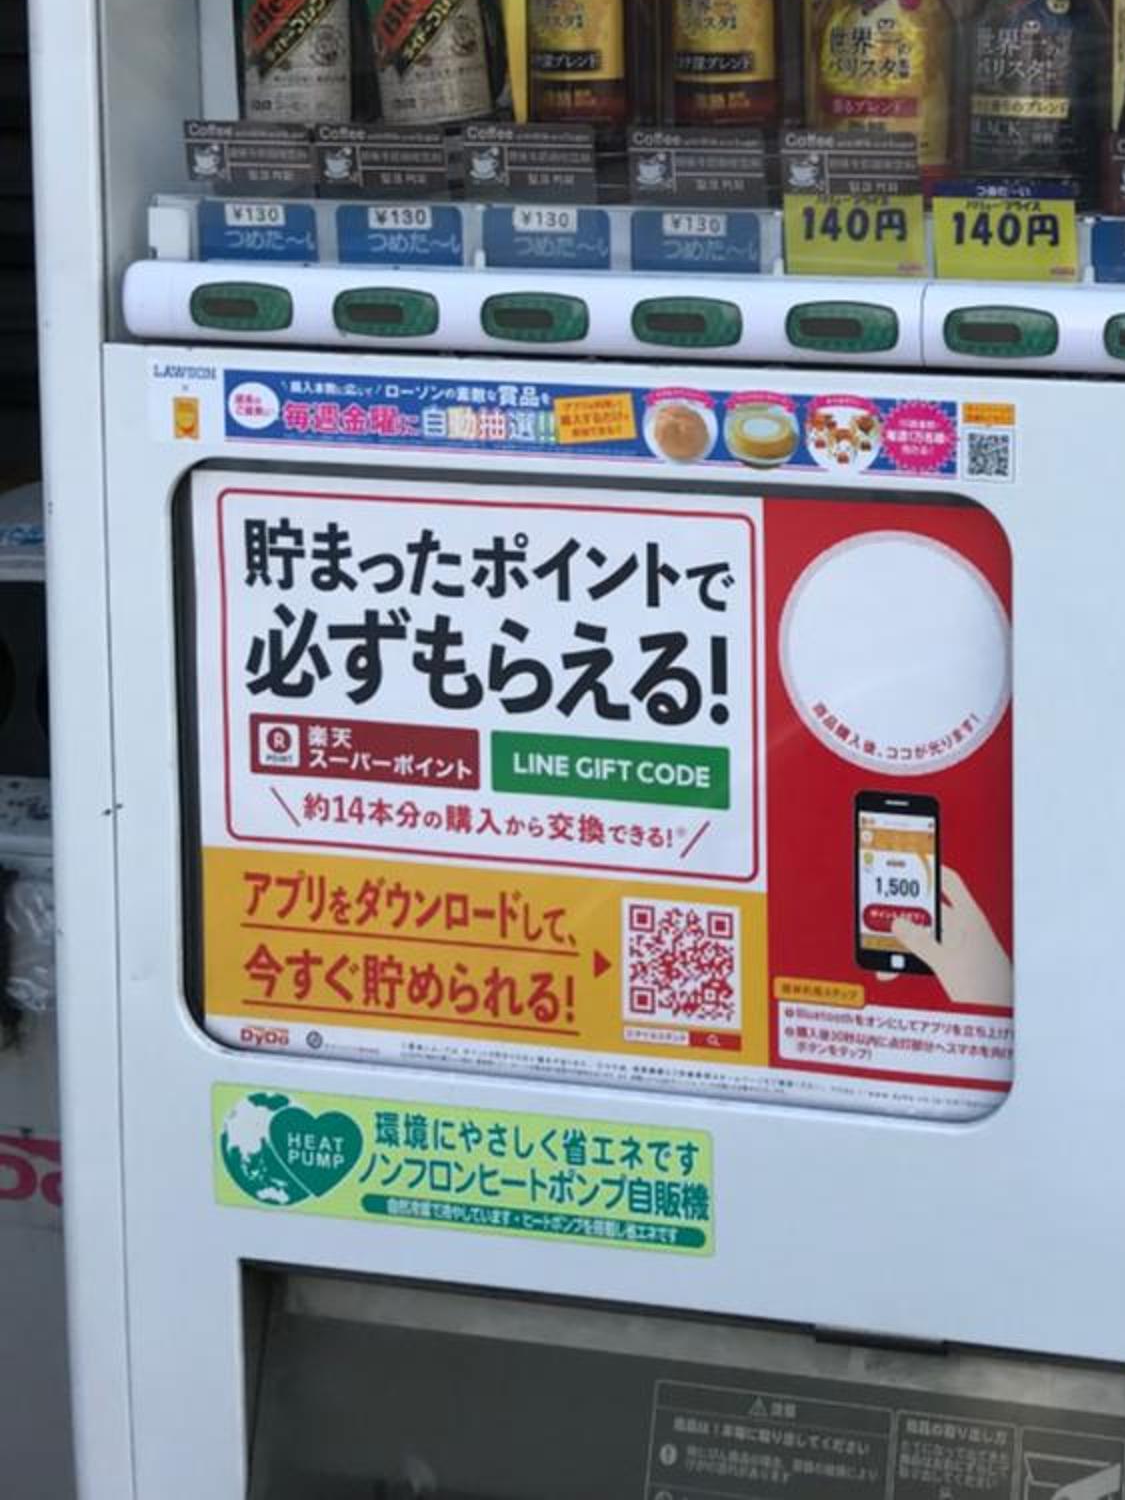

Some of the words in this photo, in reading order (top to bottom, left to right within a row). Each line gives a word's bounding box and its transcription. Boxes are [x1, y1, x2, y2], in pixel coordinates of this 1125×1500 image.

[188, 123, 232, 138] Coffee
[319, 126, 366, 141] Coffee
[467, 126, 513, 140] Coffee
[632, 131, 681, 148] Coffee
[785, 133, 835, 148] Coffee
[233, 206, 279, 224] ¥130
[374, 208, 428, 227] ¥130
[521, 210, 570, 229] ¥130
[670, 214, 722, 233] ¥130
[802, 205, 908, 242] 140円
[952, 211, 1060, 248] 140円
[245, 517, 735, 613] 貯まったポイントで
[245, 603, 730, 726] 必ずもらえる!
[307, 725, 353, 749] 楽天
[307, 748, 473, 781] スーパーポイント
[513, 751, 570, 778] LINE
[575, 755, 634, 781] GIFT
[637, 761, 711, 787] CODE
[875, 876, 920, 899] 1,500
[243, 869, 579, 947] アプリをダウンロードして、
[244, 943, 576, 1024] 今すぐ貯められる!
[287, 1132, 345, 1153] HEAT
[373, 1110, 700, 1177] 環境にやさしく省エネです
[287, 1149, 346, 1170] PUMP
[358, 1153, 710, 1222] ノンフロンヒートポンプ自販機
